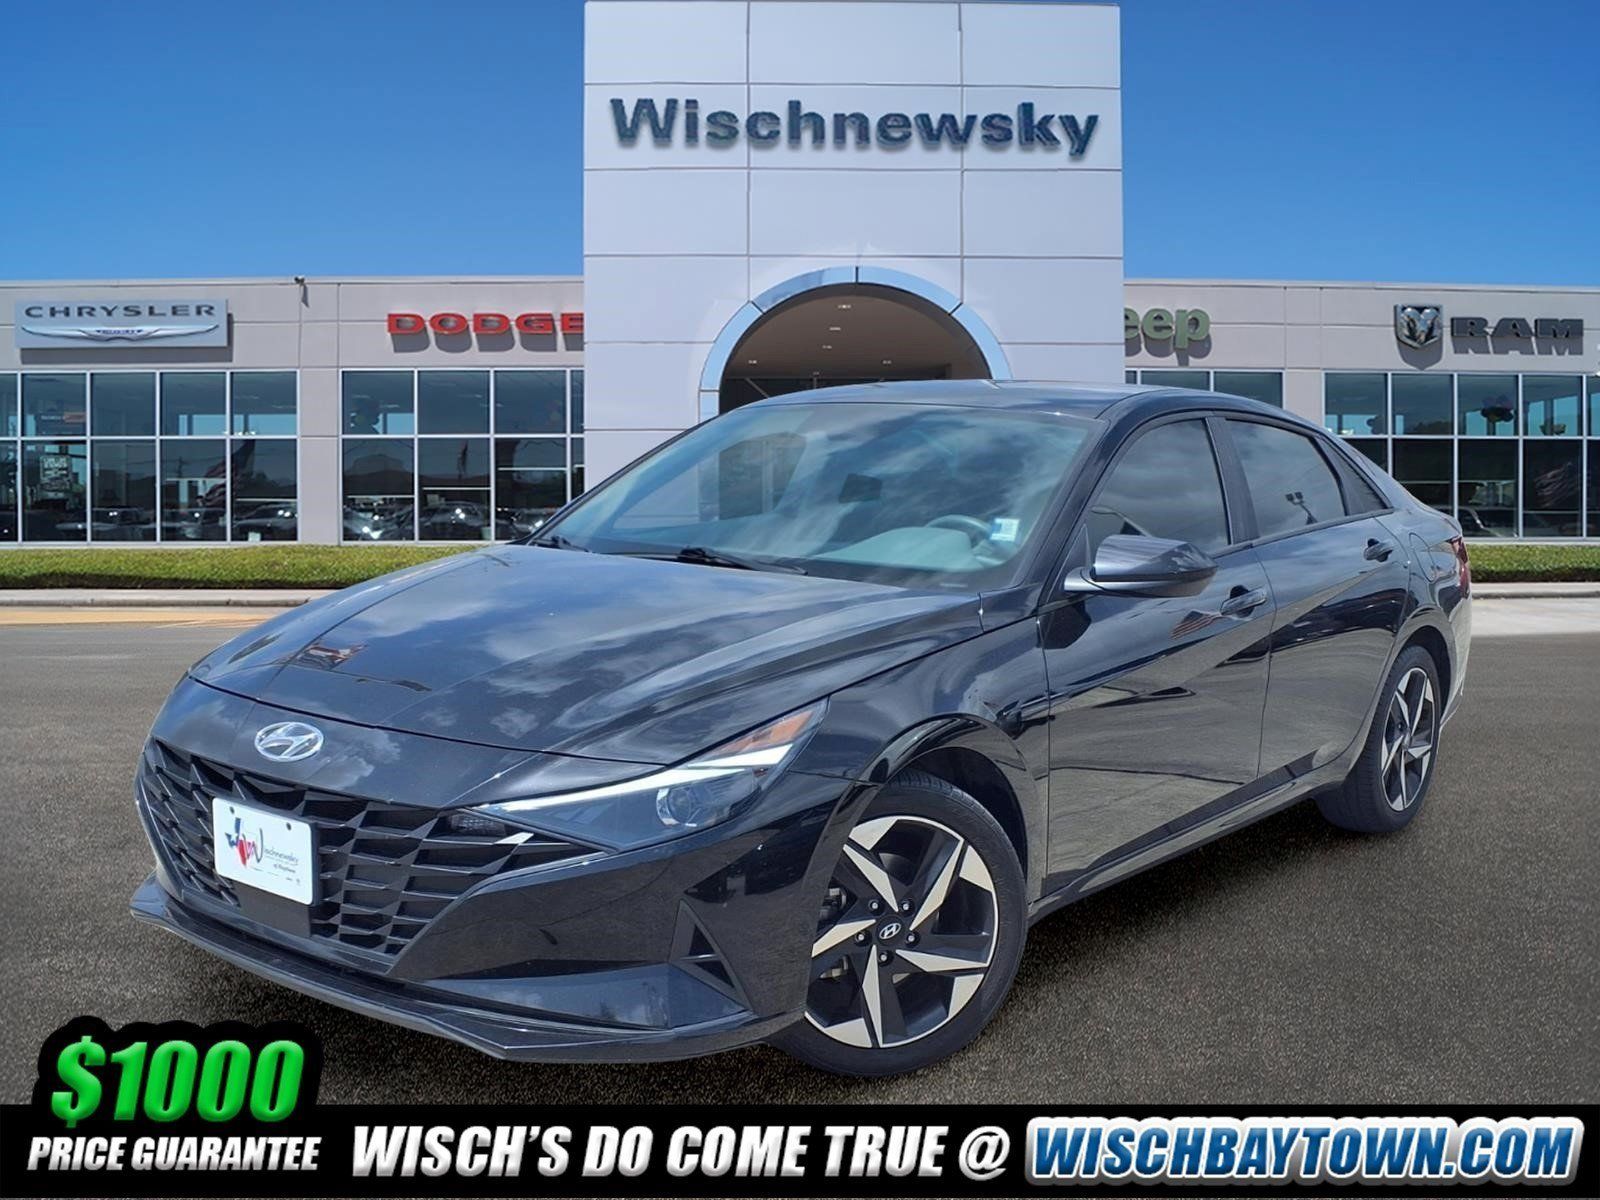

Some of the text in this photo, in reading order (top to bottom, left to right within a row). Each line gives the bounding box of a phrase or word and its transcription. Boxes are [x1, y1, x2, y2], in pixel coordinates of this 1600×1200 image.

[610, 98, 1100, 159] Wischnewsky
[25, 304, 215, 318] CHRYSLER
[387, 313, 584, 335] DODGE
[1451, 317, 1583, 339] RAM
